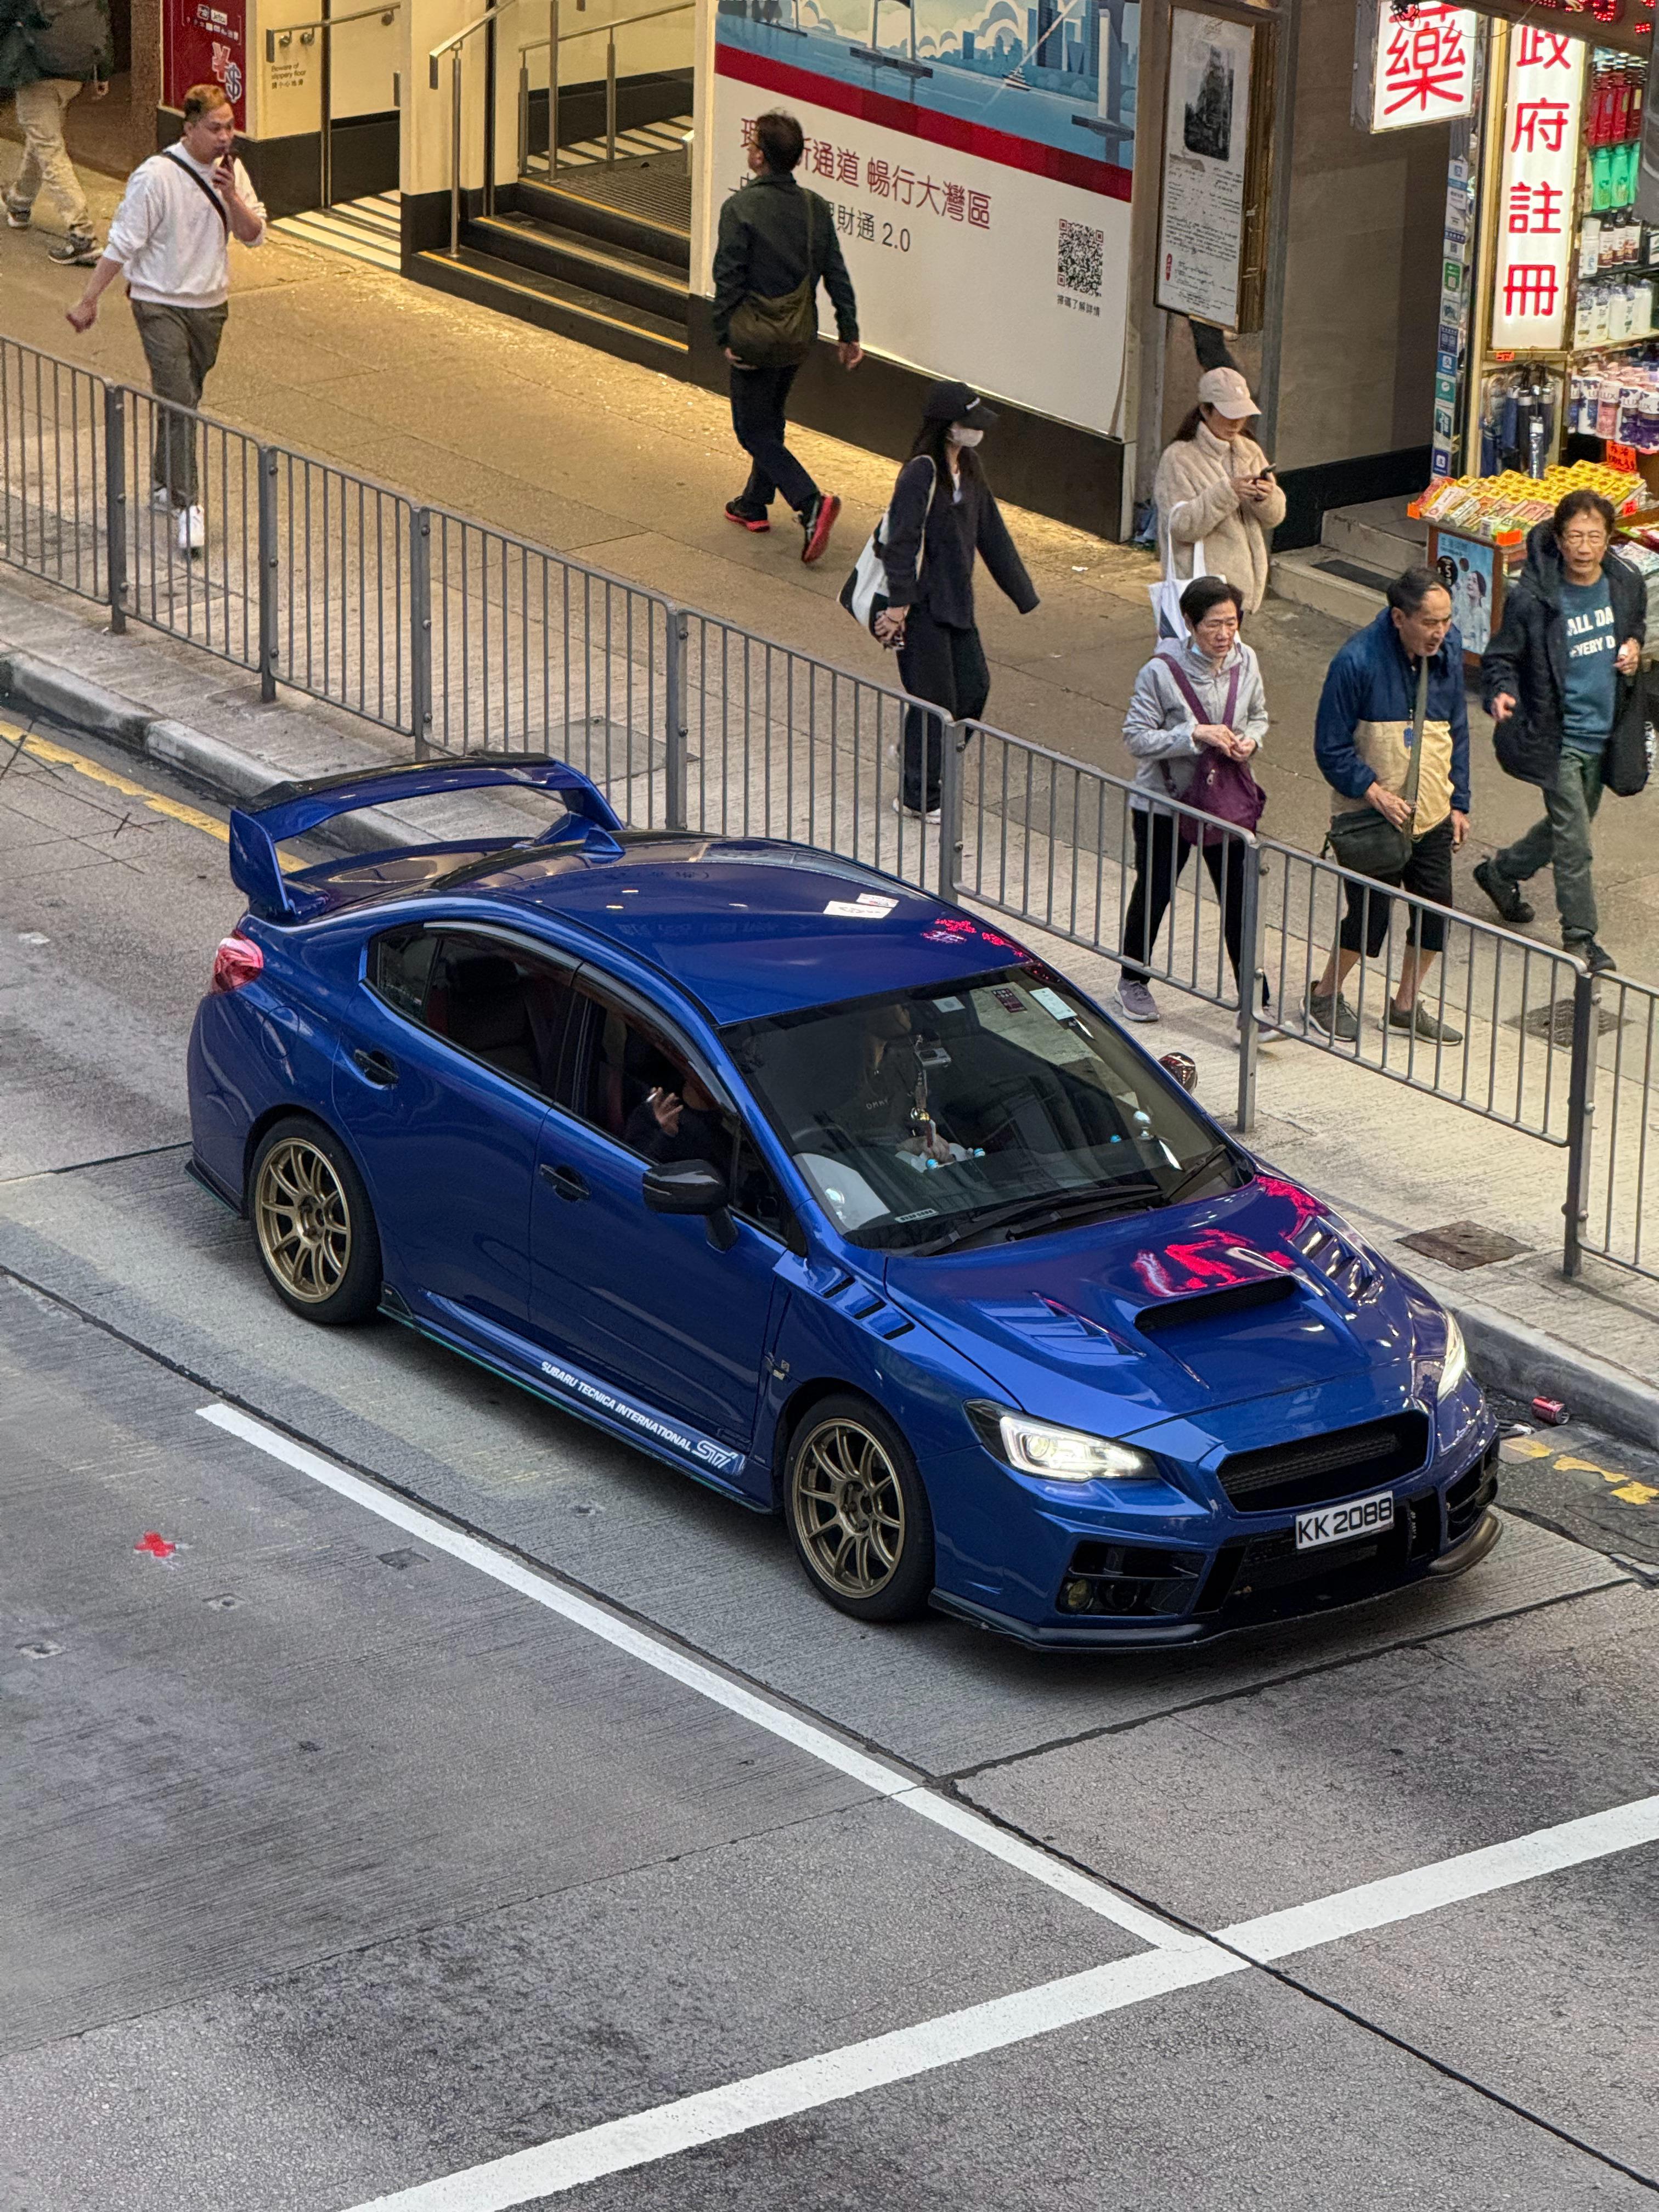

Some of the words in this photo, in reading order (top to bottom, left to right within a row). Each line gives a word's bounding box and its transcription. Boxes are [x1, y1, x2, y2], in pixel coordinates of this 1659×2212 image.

[1384, 3, 1466, 115] 藥
[867, 156, 991, 229] 暢行大灣區
[1503, 26, 1570, 317] 政府註冊
[882, 222, 910, 252] 2.0
[1567, 613, 1594, 636] ALL
[1594, 606, 1615, 627] DA
[541, 1361, 578, 1387] SUBARU
[578, 1381, 616, 1410] TECNICA
[615, 1402, 691, 1452] INTERNATIONAL
[1298, 1514, 1330, 1544] KK
[1333, 1497, 1392, 1536] 2088
